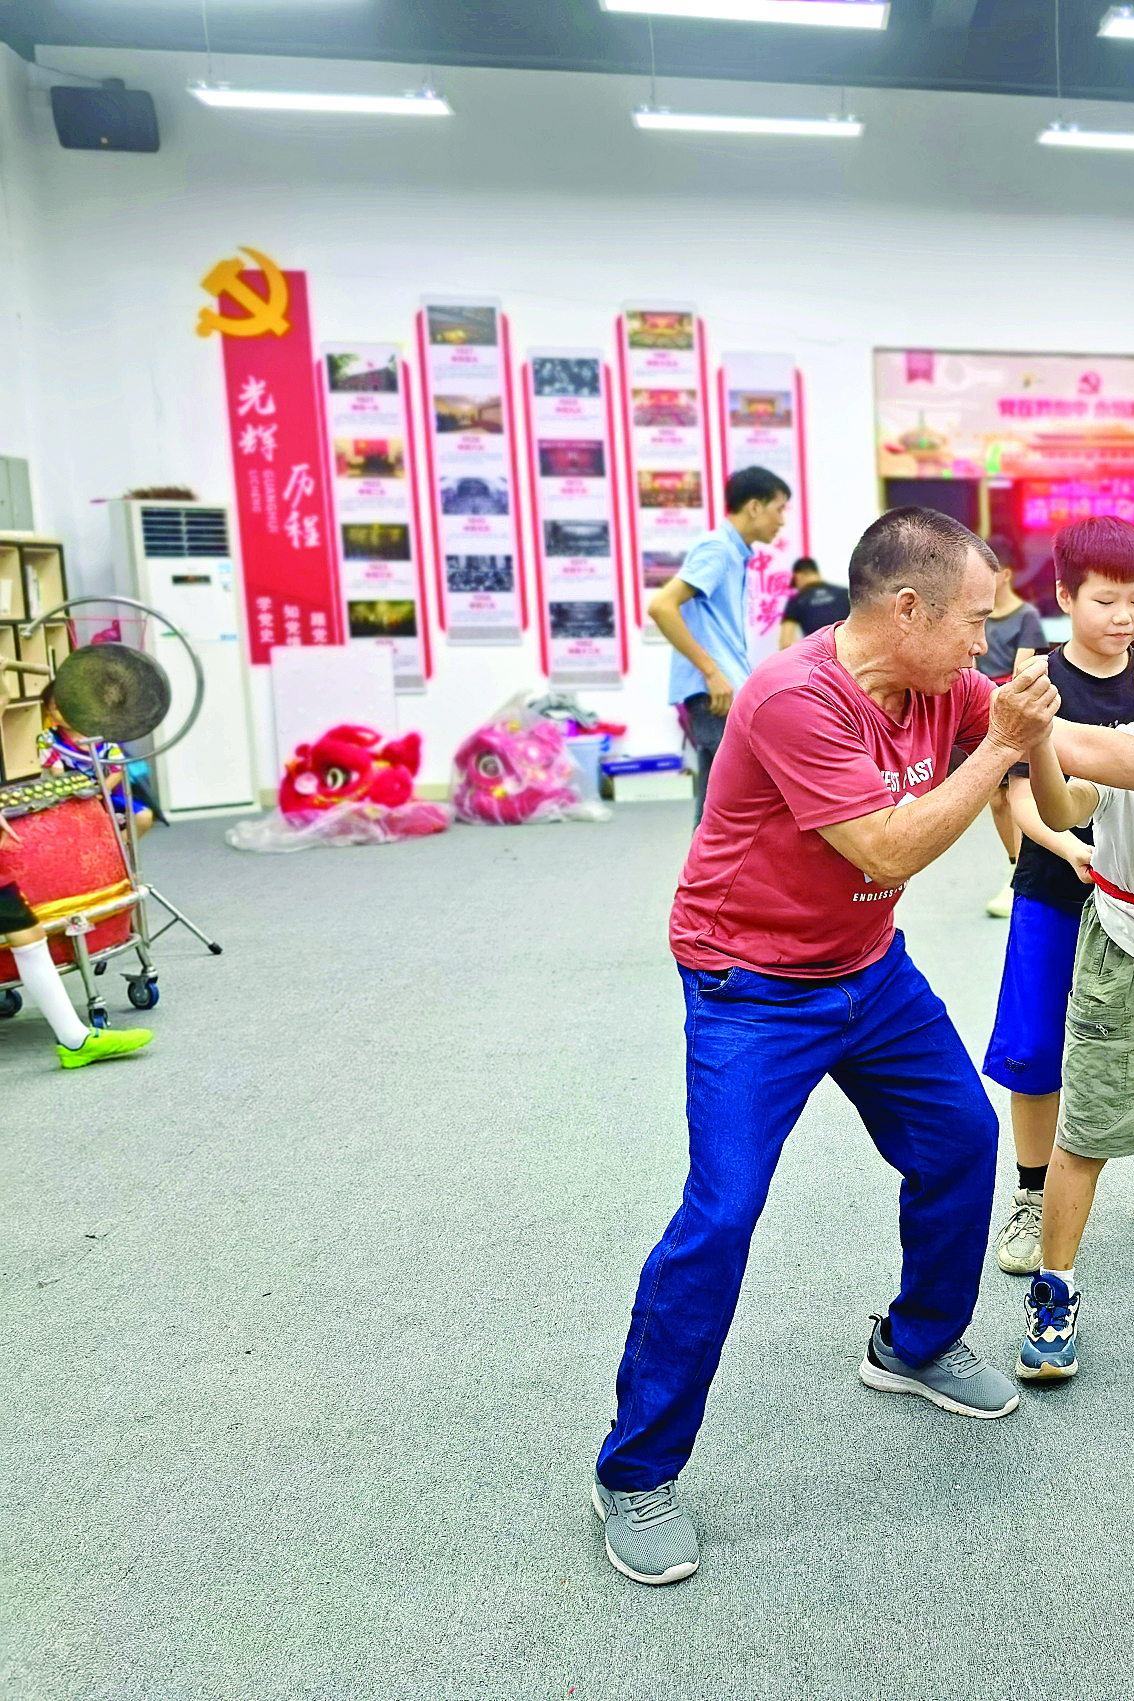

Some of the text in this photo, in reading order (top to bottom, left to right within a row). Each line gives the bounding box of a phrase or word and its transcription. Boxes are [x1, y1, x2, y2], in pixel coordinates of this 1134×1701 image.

[237, 375, 278, 462] 光辉
[248, 469, 261, 513] LICHENG
[263, 469, 279, 534] GUANGHUI
[282, 462, 320, 550] 历程
[256, 596, 275, 644] 学党史
